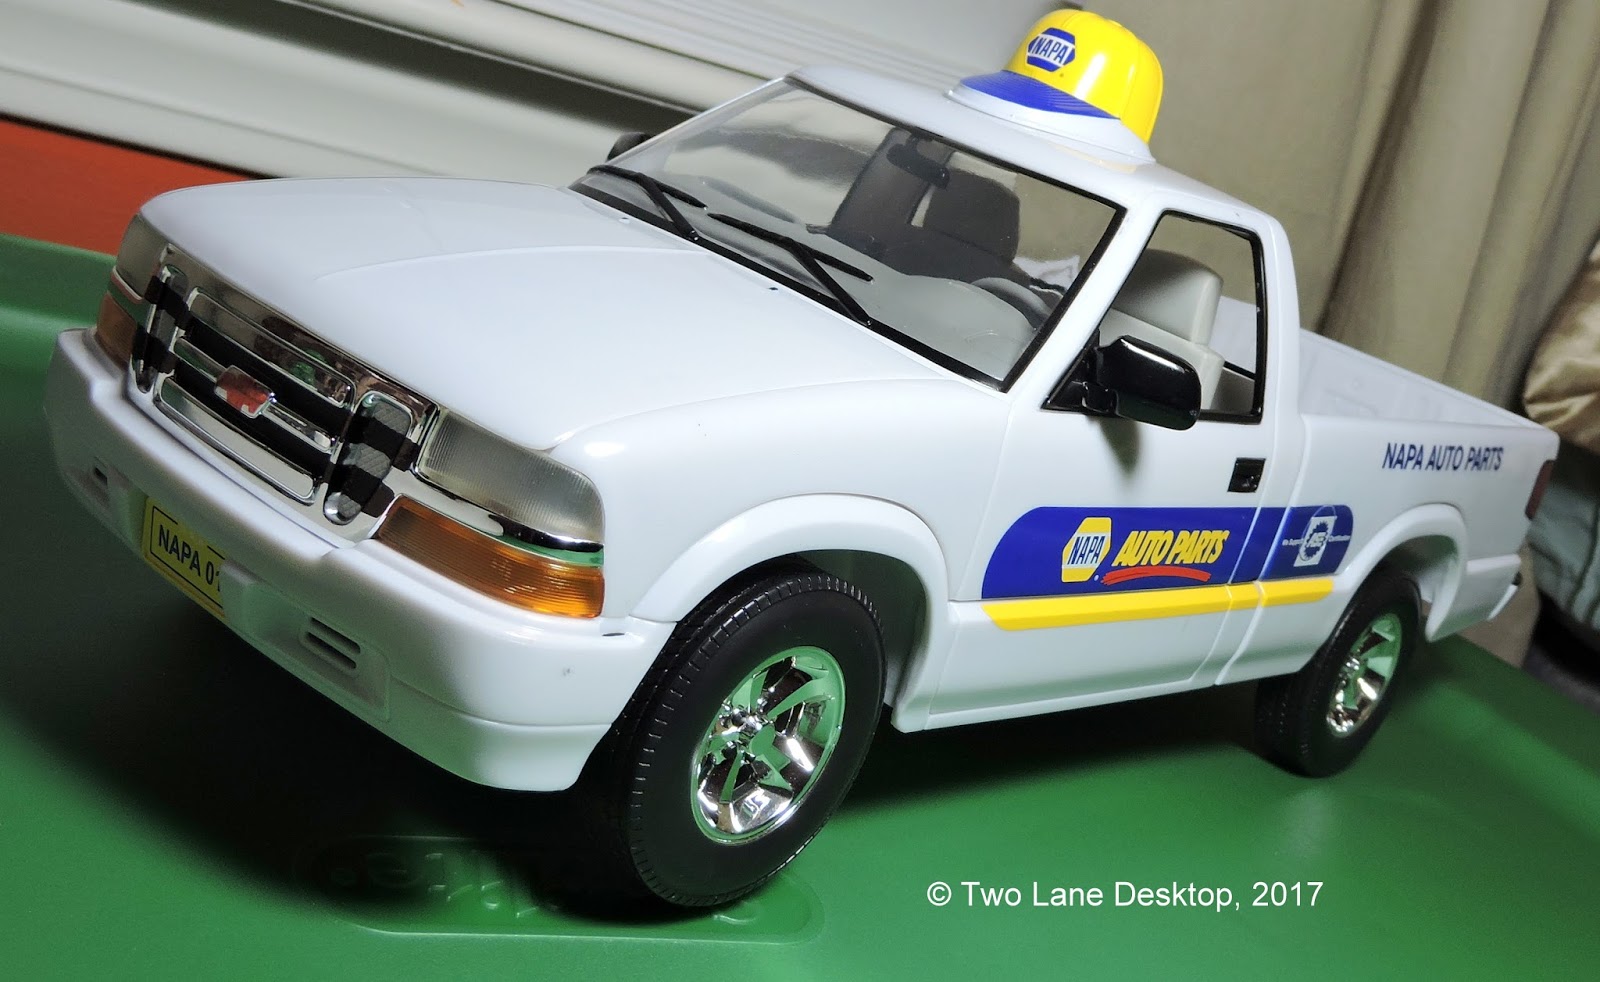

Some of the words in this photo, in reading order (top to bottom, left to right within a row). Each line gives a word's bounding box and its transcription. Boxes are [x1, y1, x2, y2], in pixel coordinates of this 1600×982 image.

[1031, 37, 1068, 64] NAPA
[1381, 442, 1424, 470] NAPA
[1425, 444, 1465, 471] AUTO
[1463, 446, 1504, 471] PARTS
[158, 524, 201, 577] NAPA
[1067, 535, 1106, 566] NAPA
[1111, 529, 1175, 567] AUTO
[1165, 529, 1231, 565] PARTS
